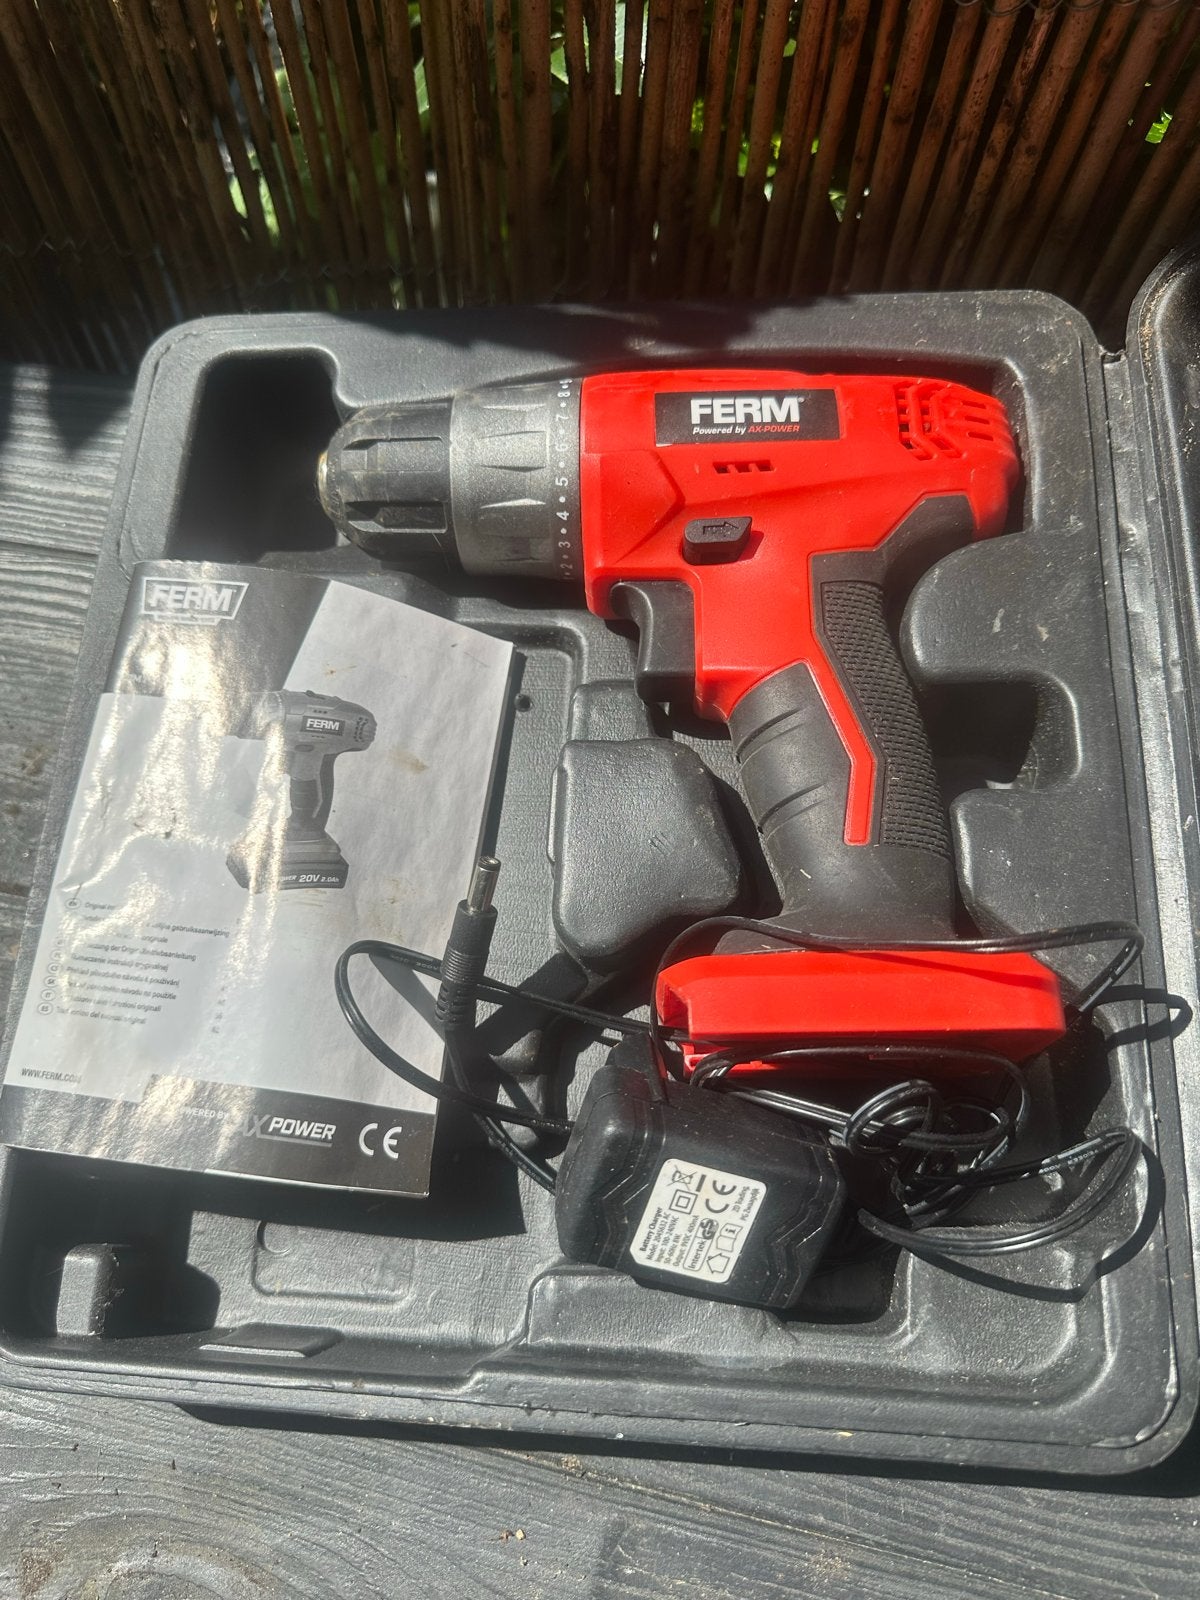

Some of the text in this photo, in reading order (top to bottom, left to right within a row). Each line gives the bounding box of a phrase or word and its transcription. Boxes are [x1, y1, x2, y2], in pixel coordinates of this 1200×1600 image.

[691, 397, 800, 424] FERM
[555, 414, 569, 422] 7
[693, 425, 800, 435] Powered by AX-POWER
[555, 442, 569, 452] 6
[555, 477, 569, 487] 5
[556, 511, 569, 521] 4
[558, 541, 571, 549] 3
[149, 584, 234, 612] FERM
[306, 718, 340, 731] FERM
[299, 875, 320, 883] 20V
[640, 1230, 655, 1251] Battery
[687, 1239, 707, 1269] Intertek
